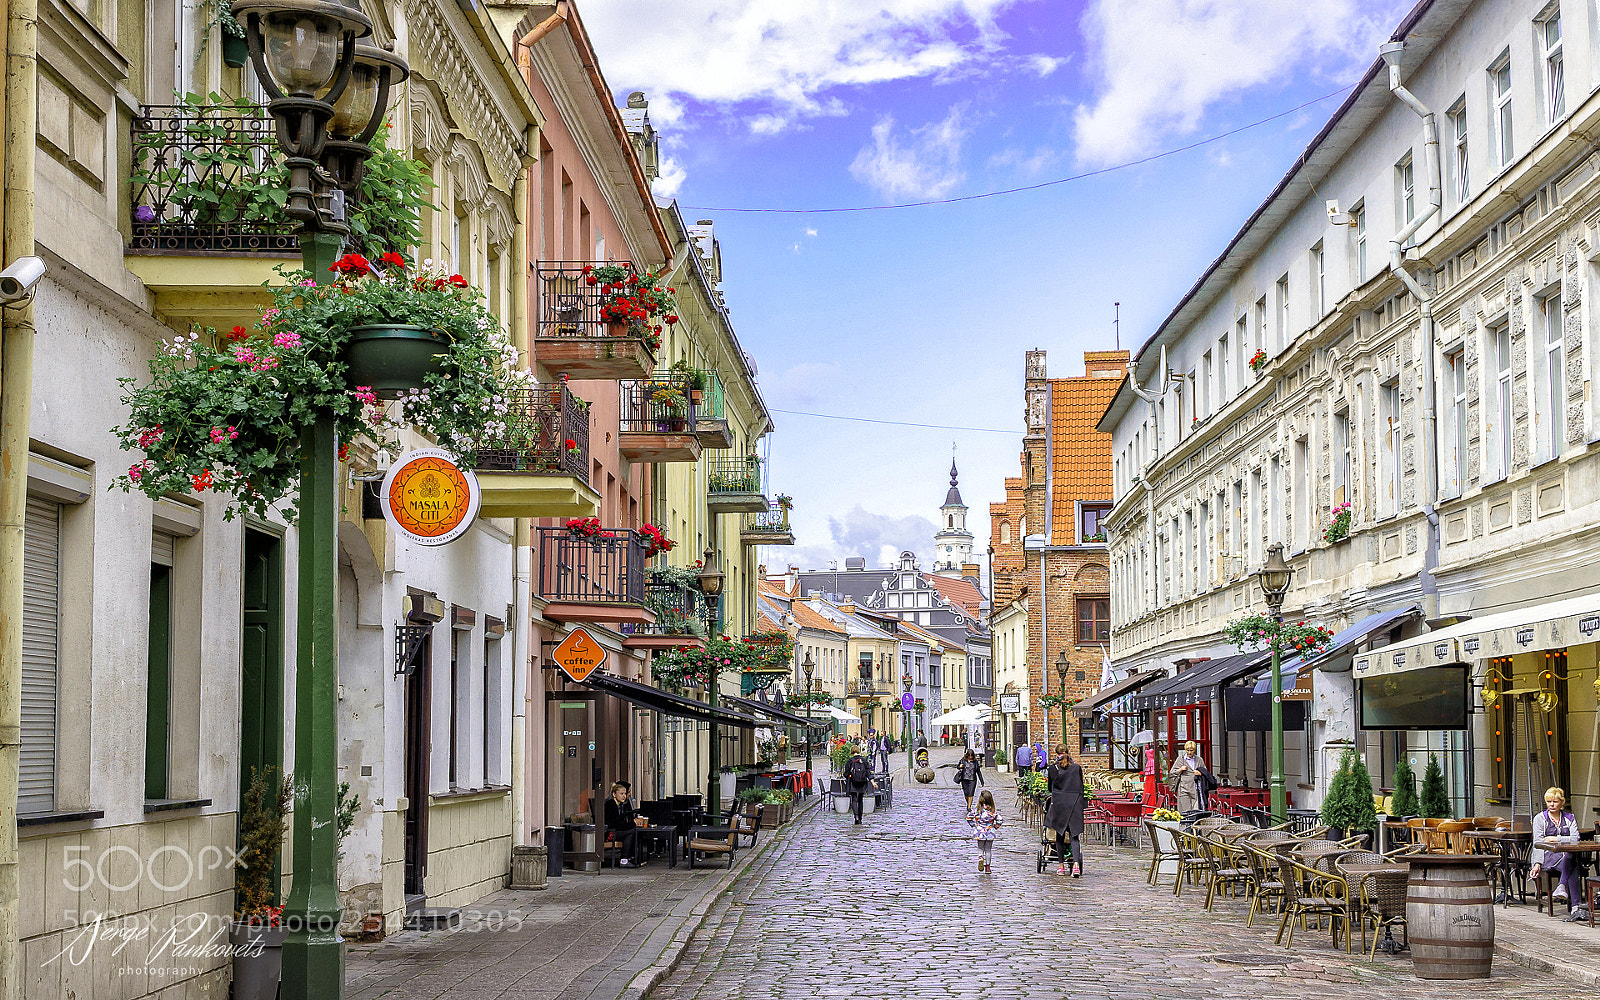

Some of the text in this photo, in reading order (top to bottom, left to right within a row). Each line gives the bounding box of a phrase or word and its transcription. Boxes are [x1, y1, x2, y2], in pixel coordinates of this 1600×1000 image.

[409, 500, 450, 511] MASALA
[420, 510, 440, 520] CITI
[563, 657, 594, 665] coffee
[572, 665, 586, 674] inn
